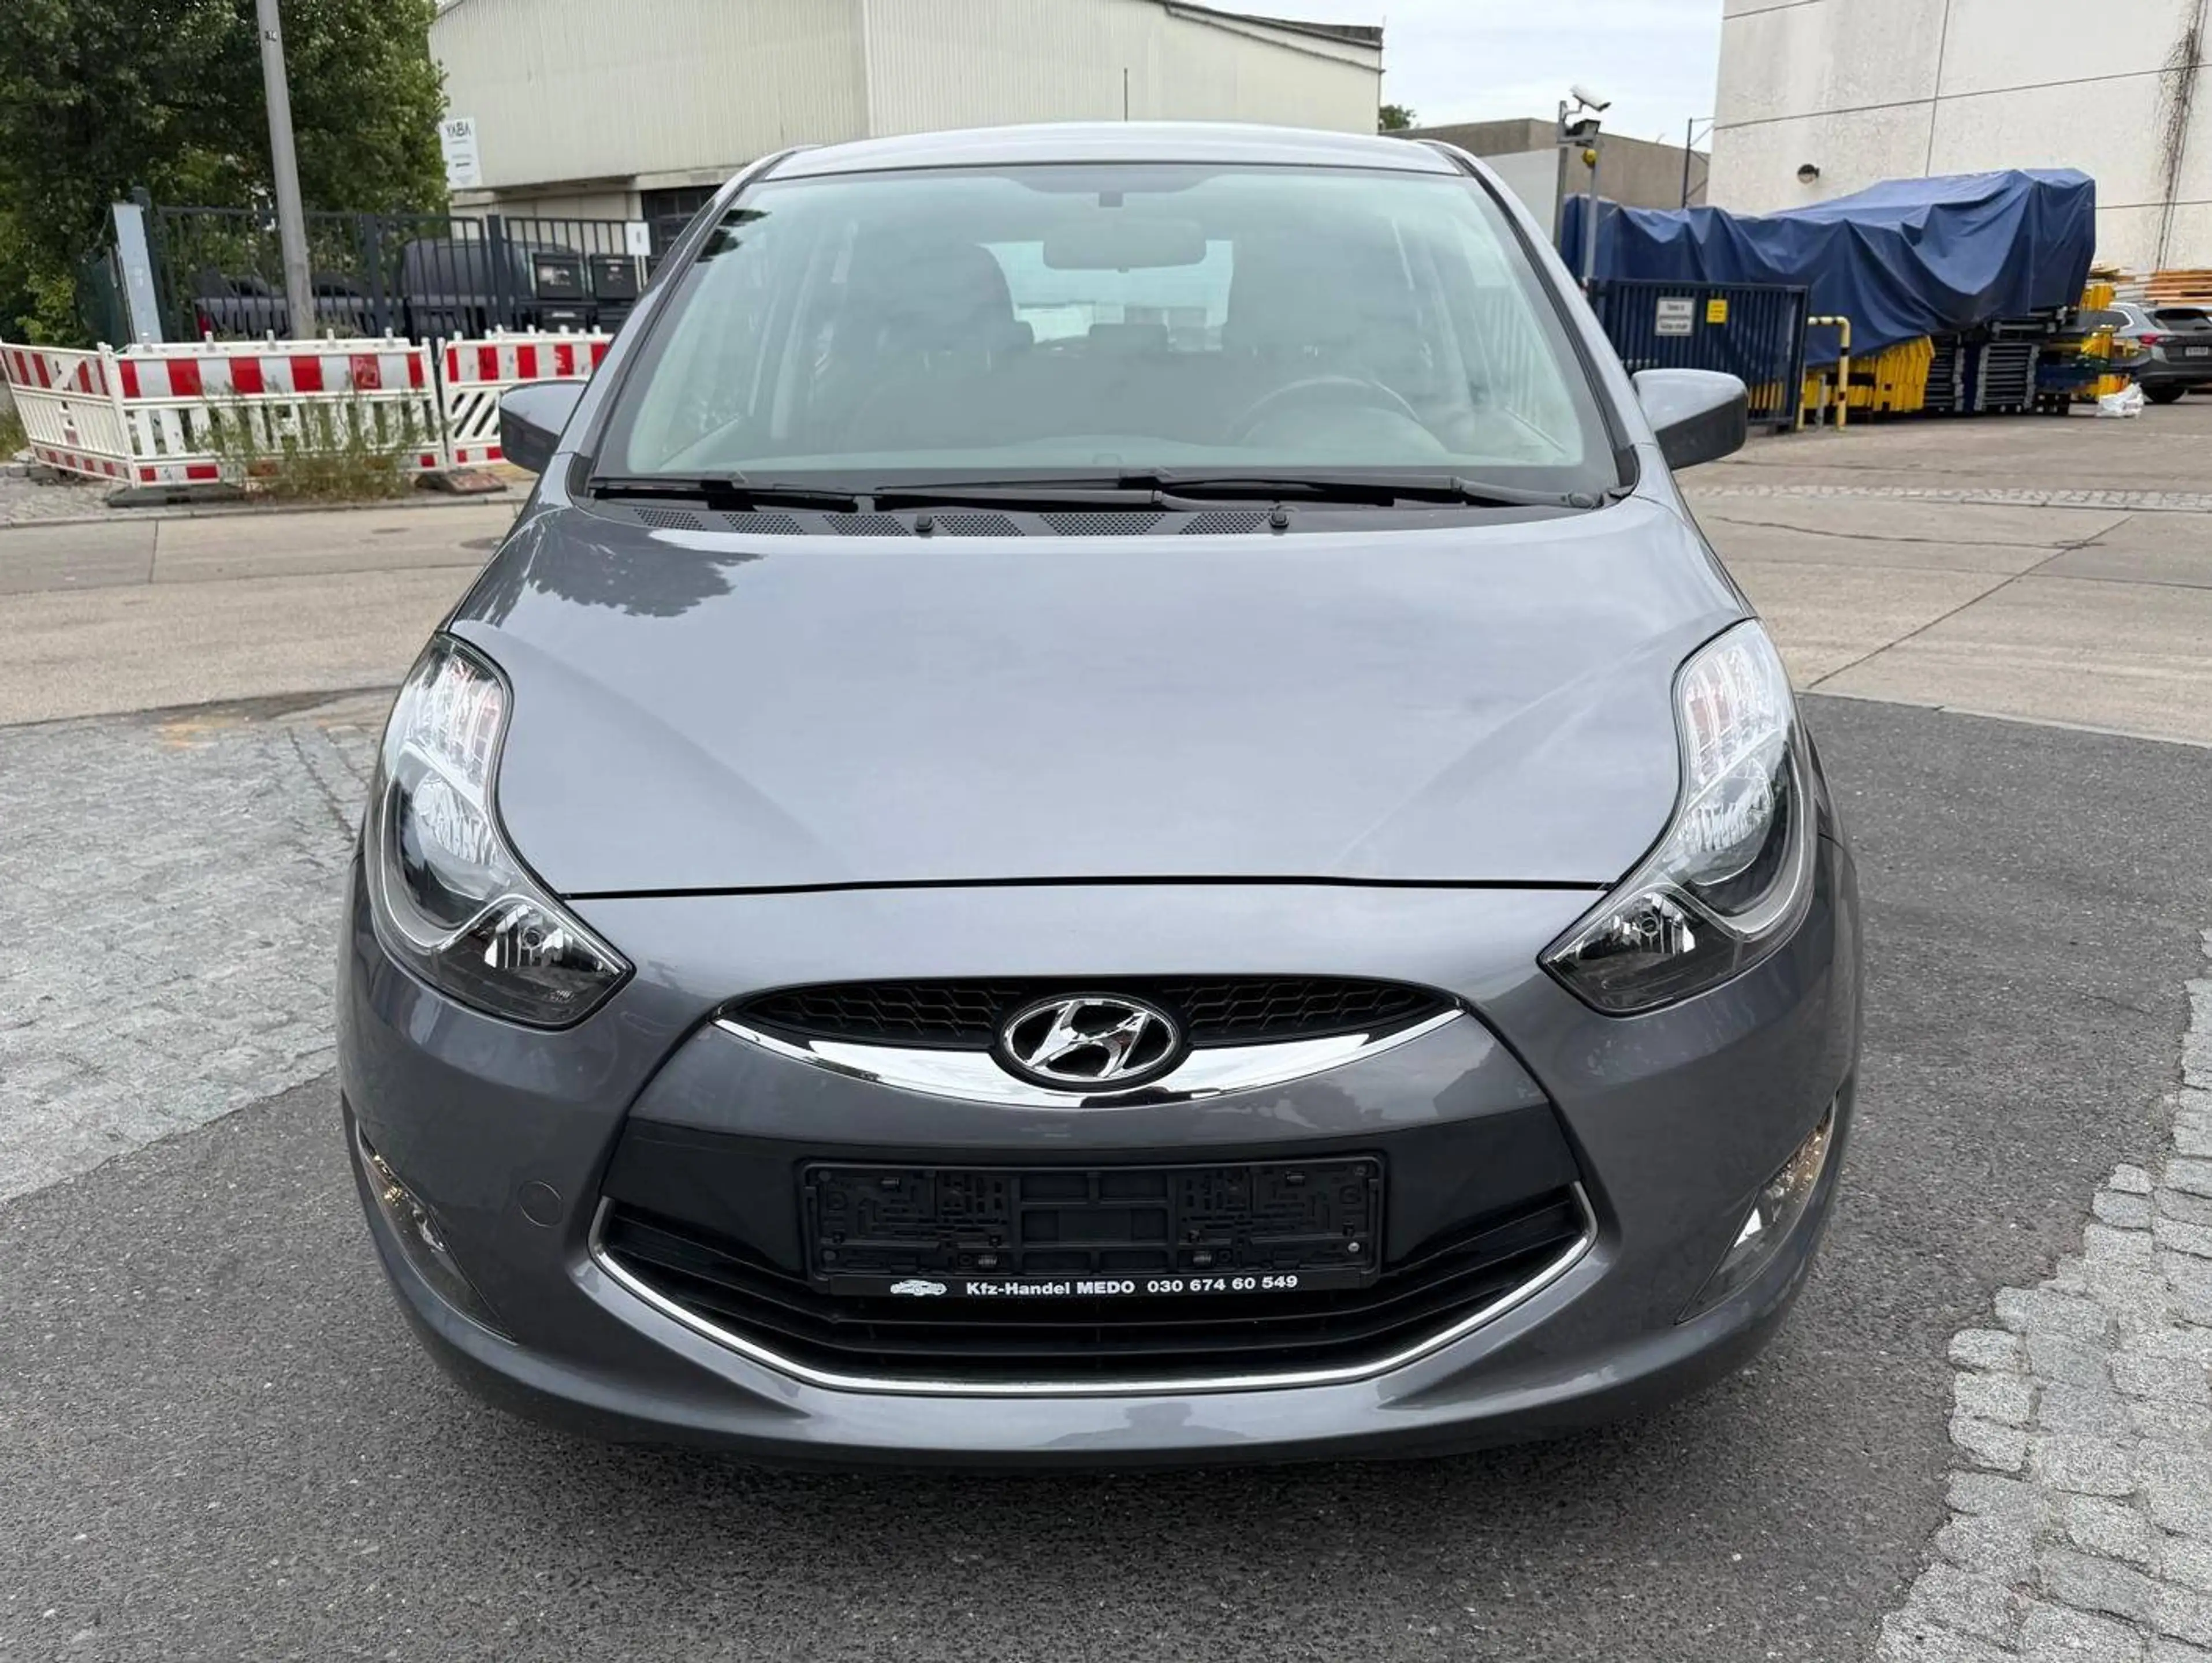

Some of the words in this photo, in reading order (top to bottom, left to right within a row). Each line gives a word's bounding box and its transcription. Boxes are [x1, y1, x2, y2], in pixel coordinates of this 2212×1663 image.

[966, 1281, 1071, 1295] Kfz-Handel
[1076, 1280, 1135, 1295] MEDO
[1147, 1280, 1183, 1293] 030
[1189, 1278, 1227, 1292] 674
[1231, 1277, 1257, 1291] 60
[1261, 1275, 1298, 1289] 549
